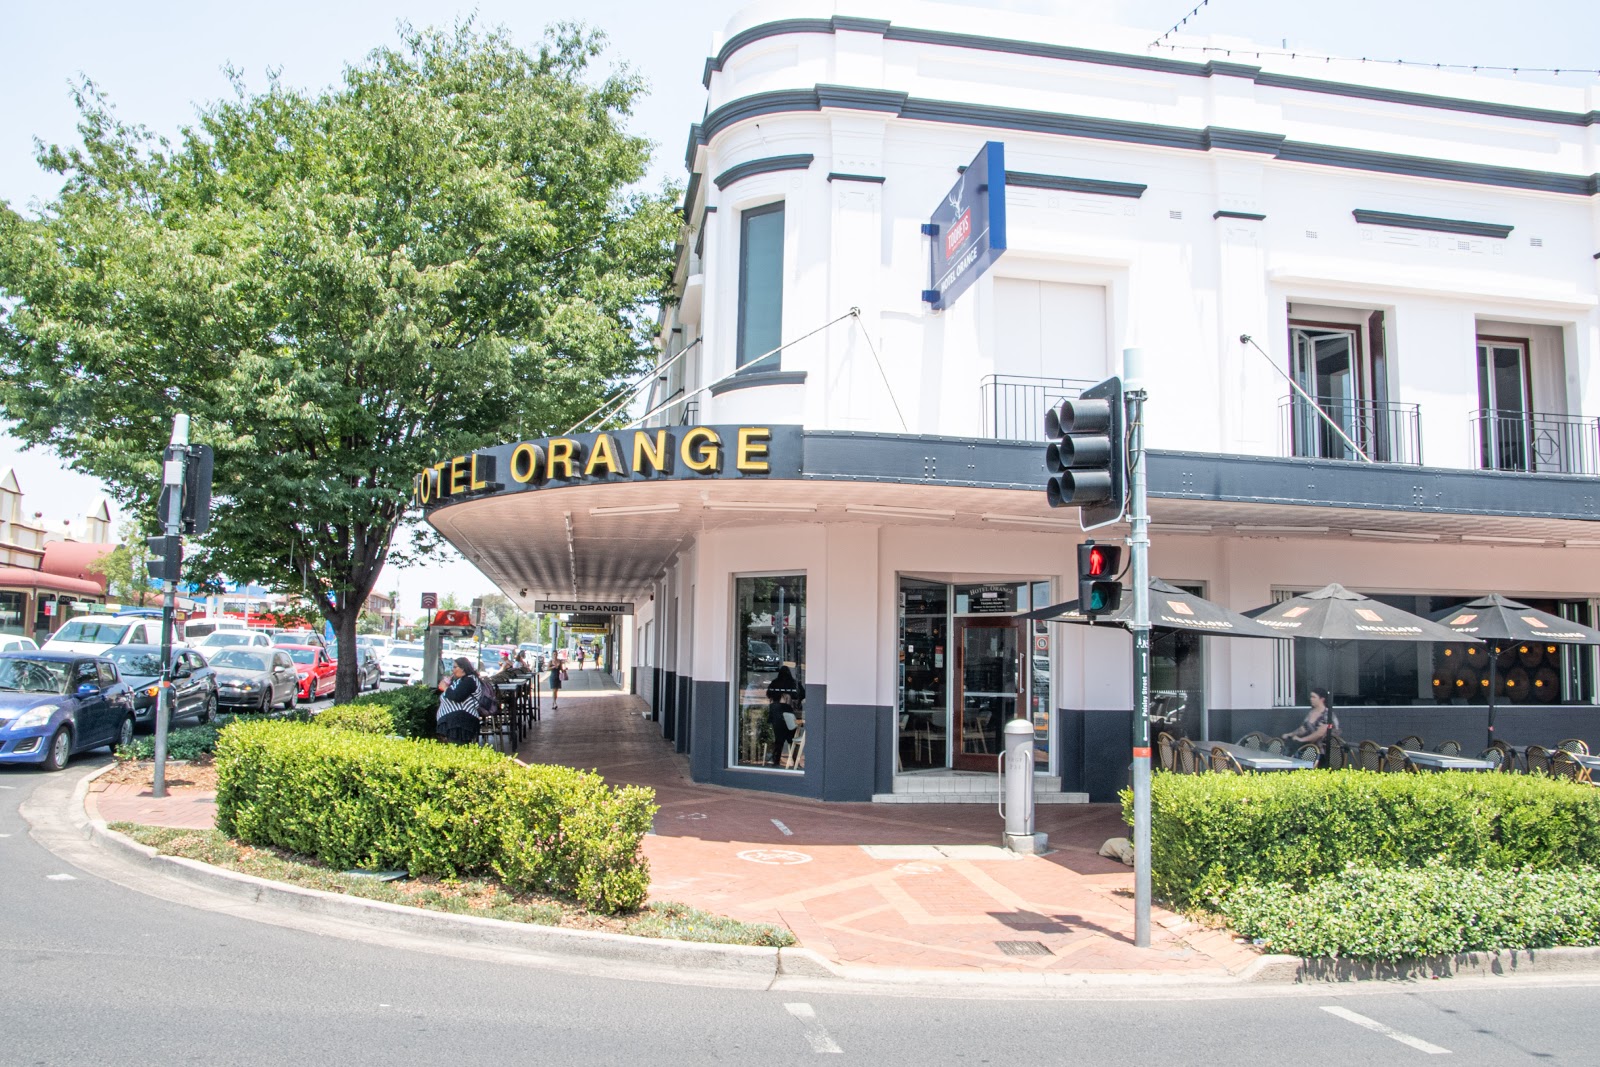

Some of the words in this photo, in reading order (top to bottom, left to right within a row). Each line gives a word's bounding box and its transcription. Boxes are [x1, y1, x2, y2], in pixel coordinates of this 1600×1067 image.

[947, 215, 969, 250] TOOHEYS
[940, 270, 956, 293] HOTEL
[956, 246, 978, 277] ORANGE
[510, 427, 769, 483] ORANGE
